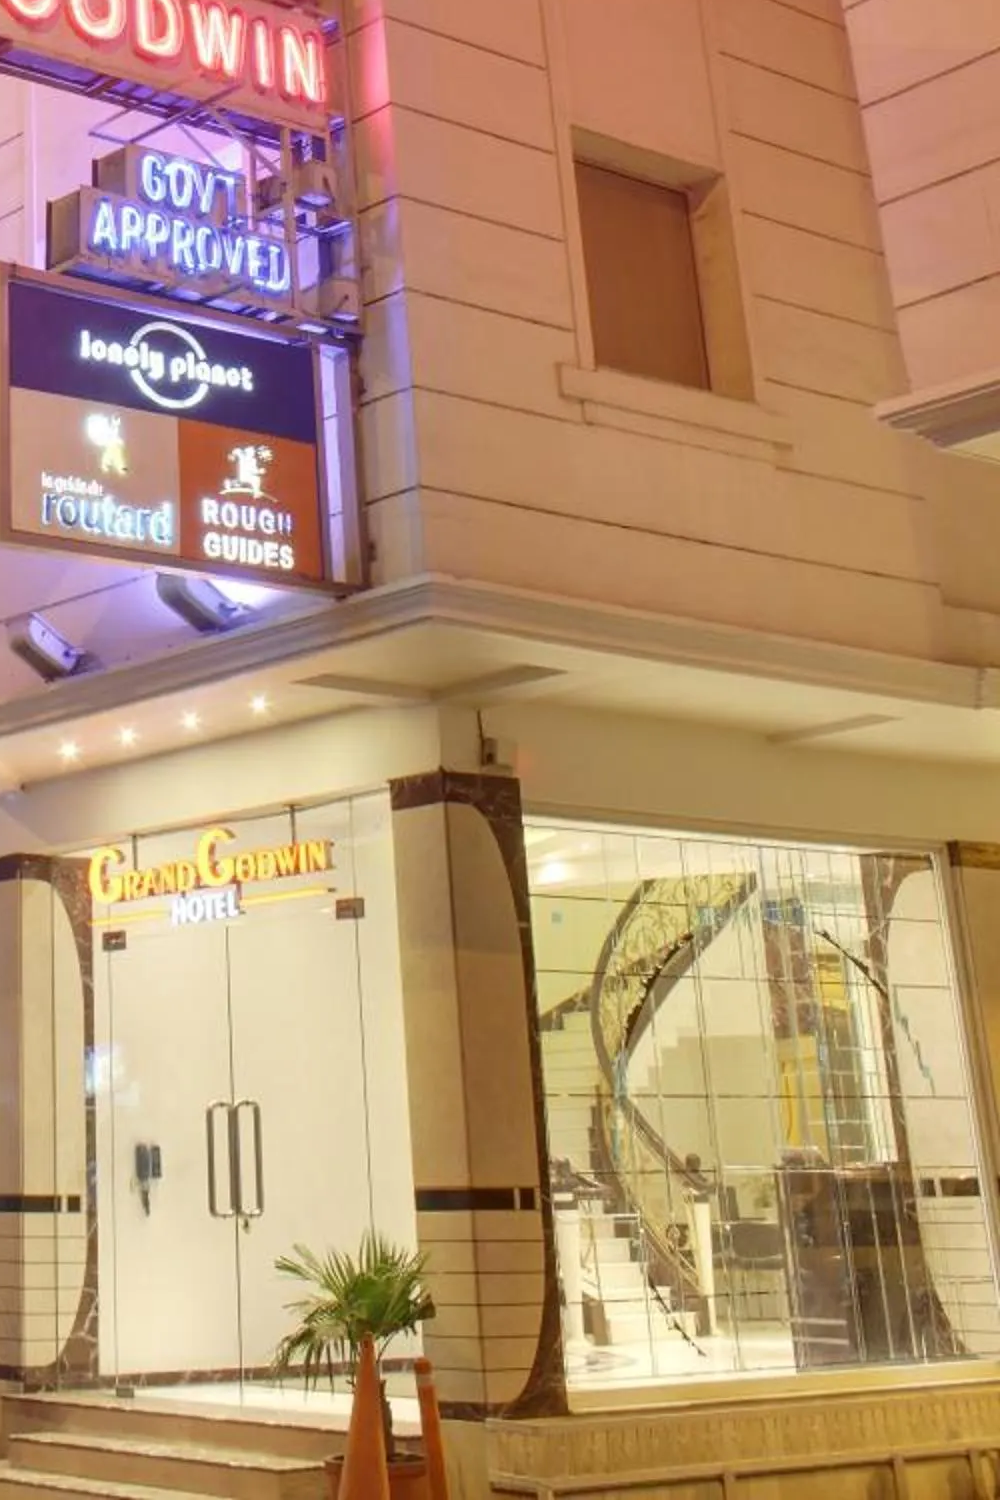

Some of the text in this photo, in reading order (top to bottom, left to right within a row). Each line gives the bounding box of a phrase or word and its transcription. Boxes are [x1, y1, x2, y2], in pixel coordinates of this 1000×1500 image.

[92, 201, 293, 293] APPROVED
[79, 329, 254, 392] lonely planet
[42, 492, 174, 547] routard
[202, 498, 292, 535] ROUGH
[203, 531, 295, 570] GUIDES
[171, 889, 240, 925] HOTEL
